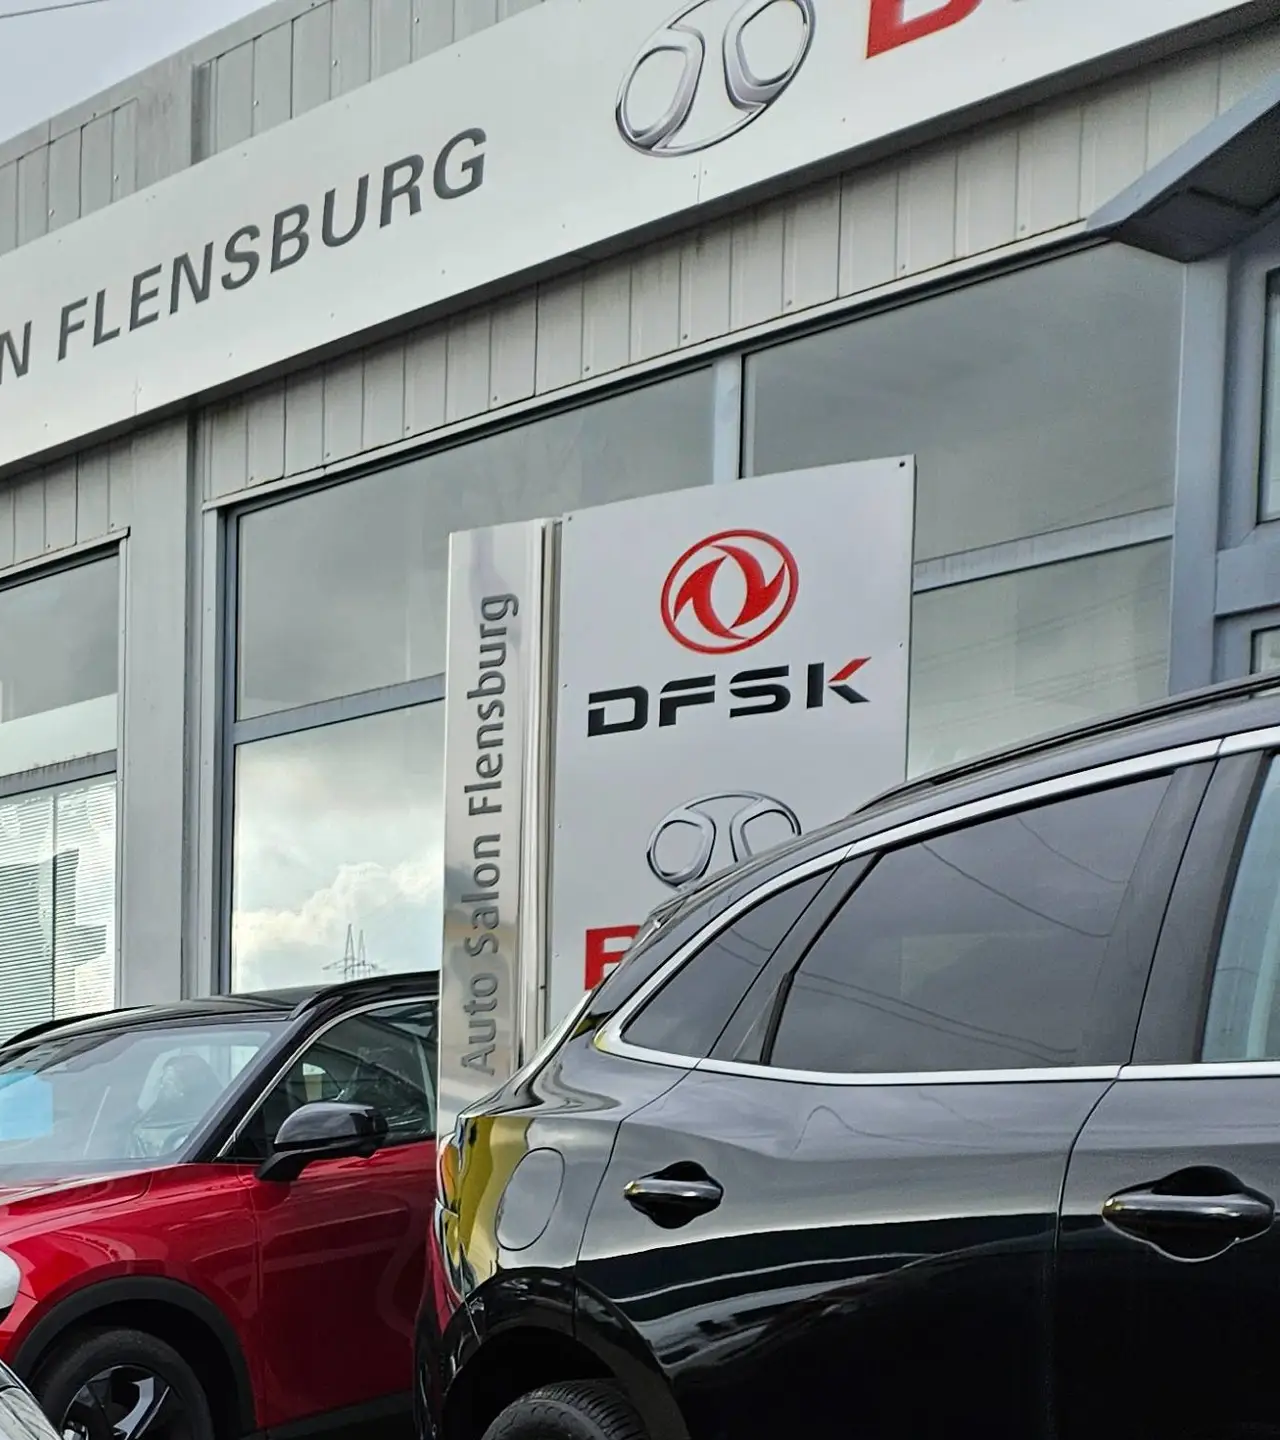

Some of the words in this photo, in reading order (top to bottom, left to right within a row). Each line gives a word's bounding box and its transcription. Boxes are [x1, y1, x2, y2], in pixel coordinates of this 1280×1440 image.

[57, 126, 488, 363] FLENSBURG
[463, 592, 520, 817] Flensburg
[586, 655, 873, 738] DFSK
[460, 833, 502, 961] Salon
[459, 975, 498, 1077] Auto
